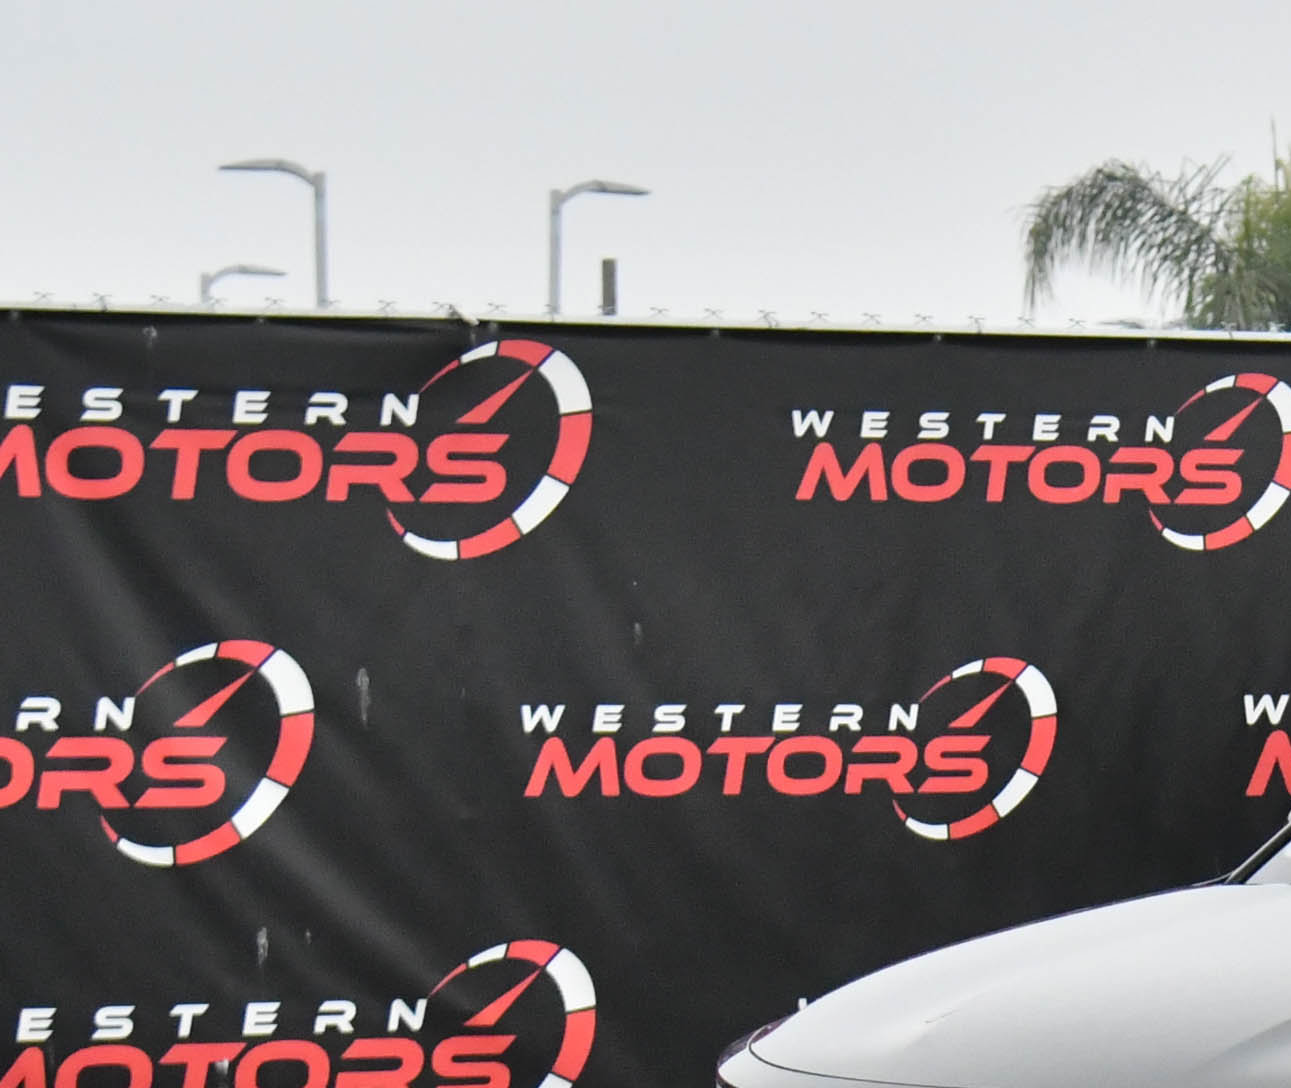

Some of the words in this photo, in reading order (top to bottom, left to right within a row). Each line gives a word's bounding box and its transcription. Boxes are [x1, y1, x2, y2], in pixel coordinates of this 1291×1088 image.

[791, 409, 1175, 443] WESTERN
[794, 441, 1244, 506] MOTORS
[520, 703, 920, 734] WESTERN
[523, 734, 992, 798] MOTORS
